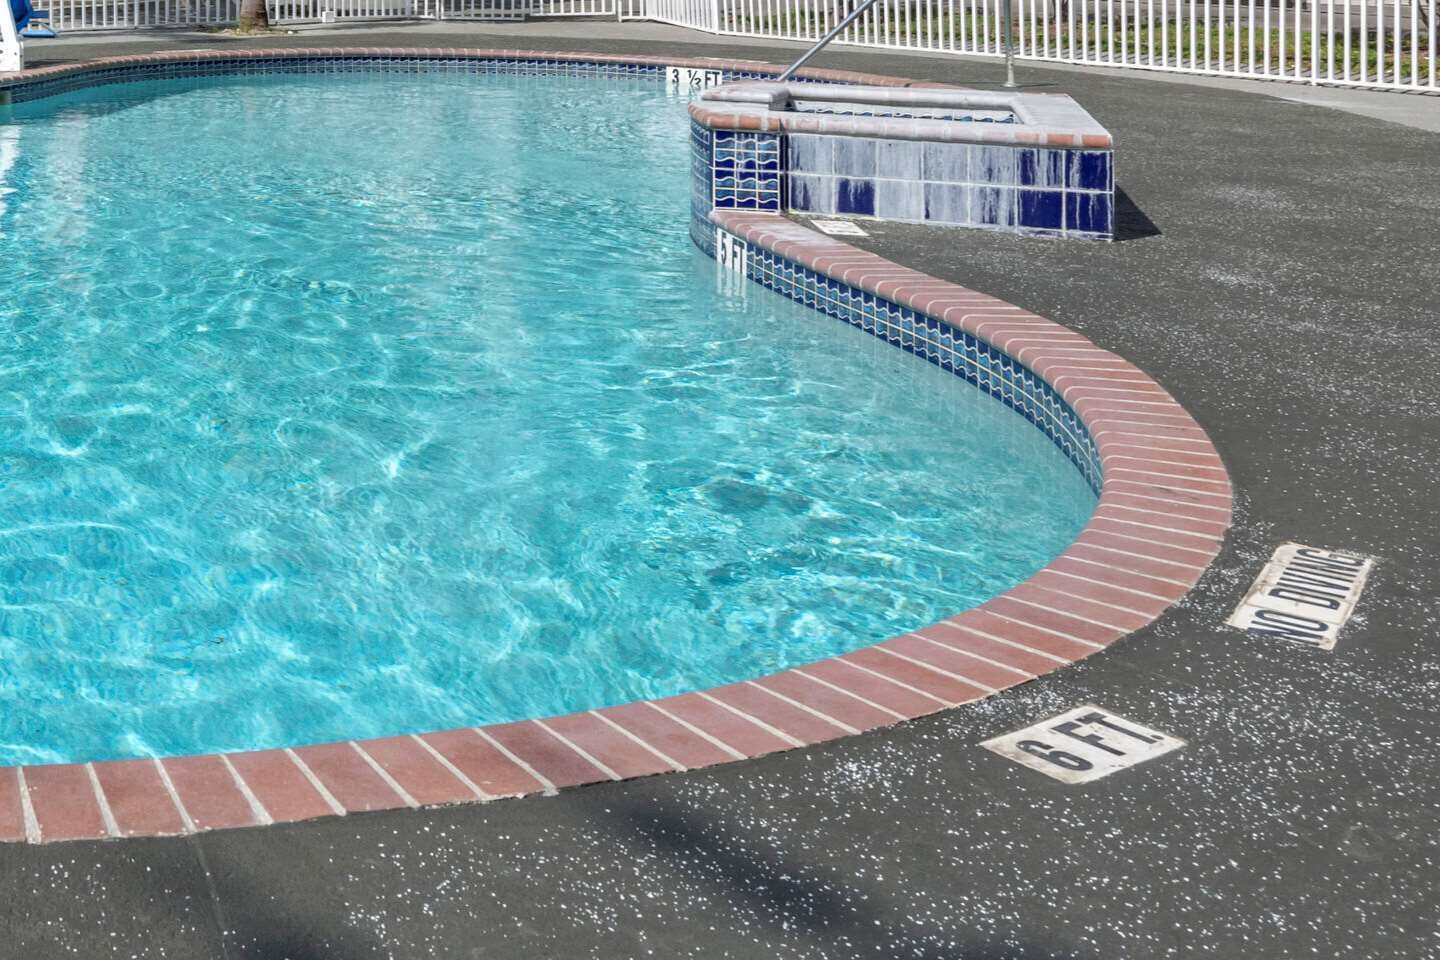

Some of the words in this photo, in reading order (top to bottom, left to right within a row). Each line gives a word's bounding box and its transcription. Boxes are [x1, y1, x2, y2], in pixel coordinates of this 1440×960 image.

[672, 68, 679, 83] 3
[705, 71, 720, 87] FT
[721, 232, 727, 264] 5
[732, 238, 745, 273] FT
[1268, 548, 1364, 610] DIVING
[1248, 609, 1328, 646] NO
[1016, 740, 1094, 771] 6
